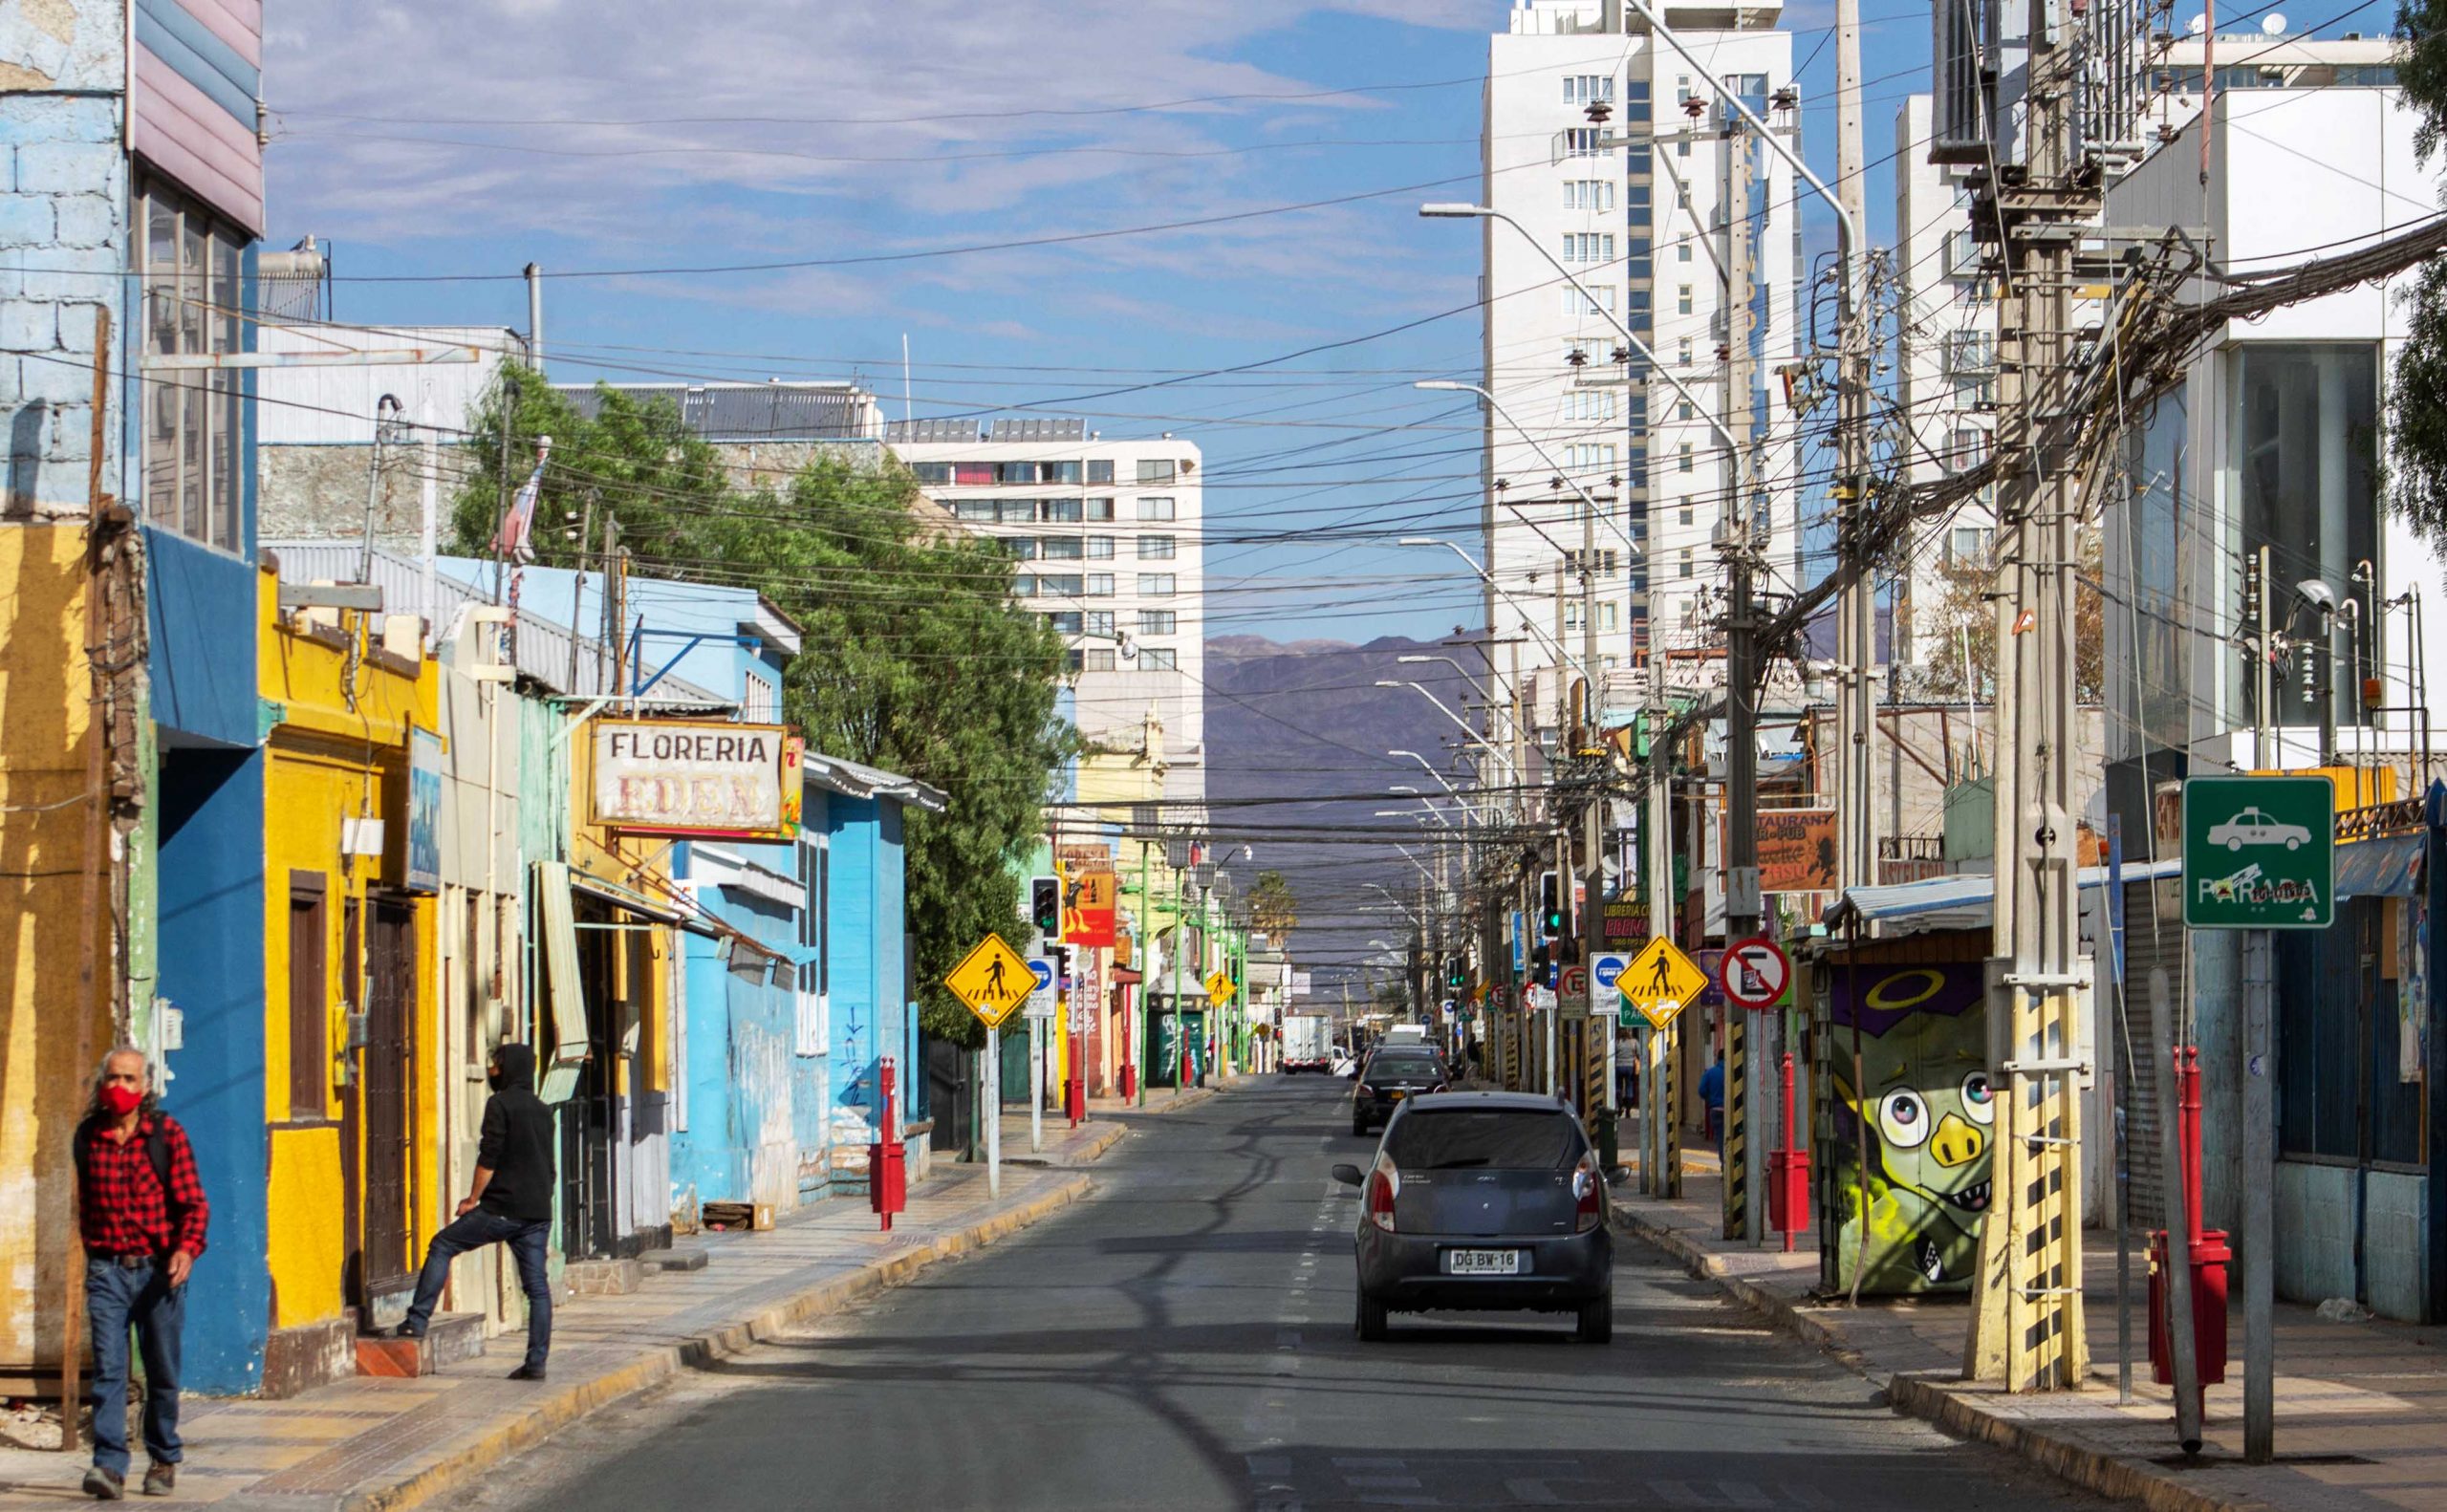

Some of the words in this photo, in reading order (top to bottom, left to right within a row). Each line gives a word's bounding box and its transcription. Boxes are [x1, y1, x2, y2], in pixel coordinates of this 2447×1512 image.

[611, 732, 768, 763] FLORERIA
[618, 774, 761, 816] EDEN
[1604, 904, 1639, 917] LIBRERIA
